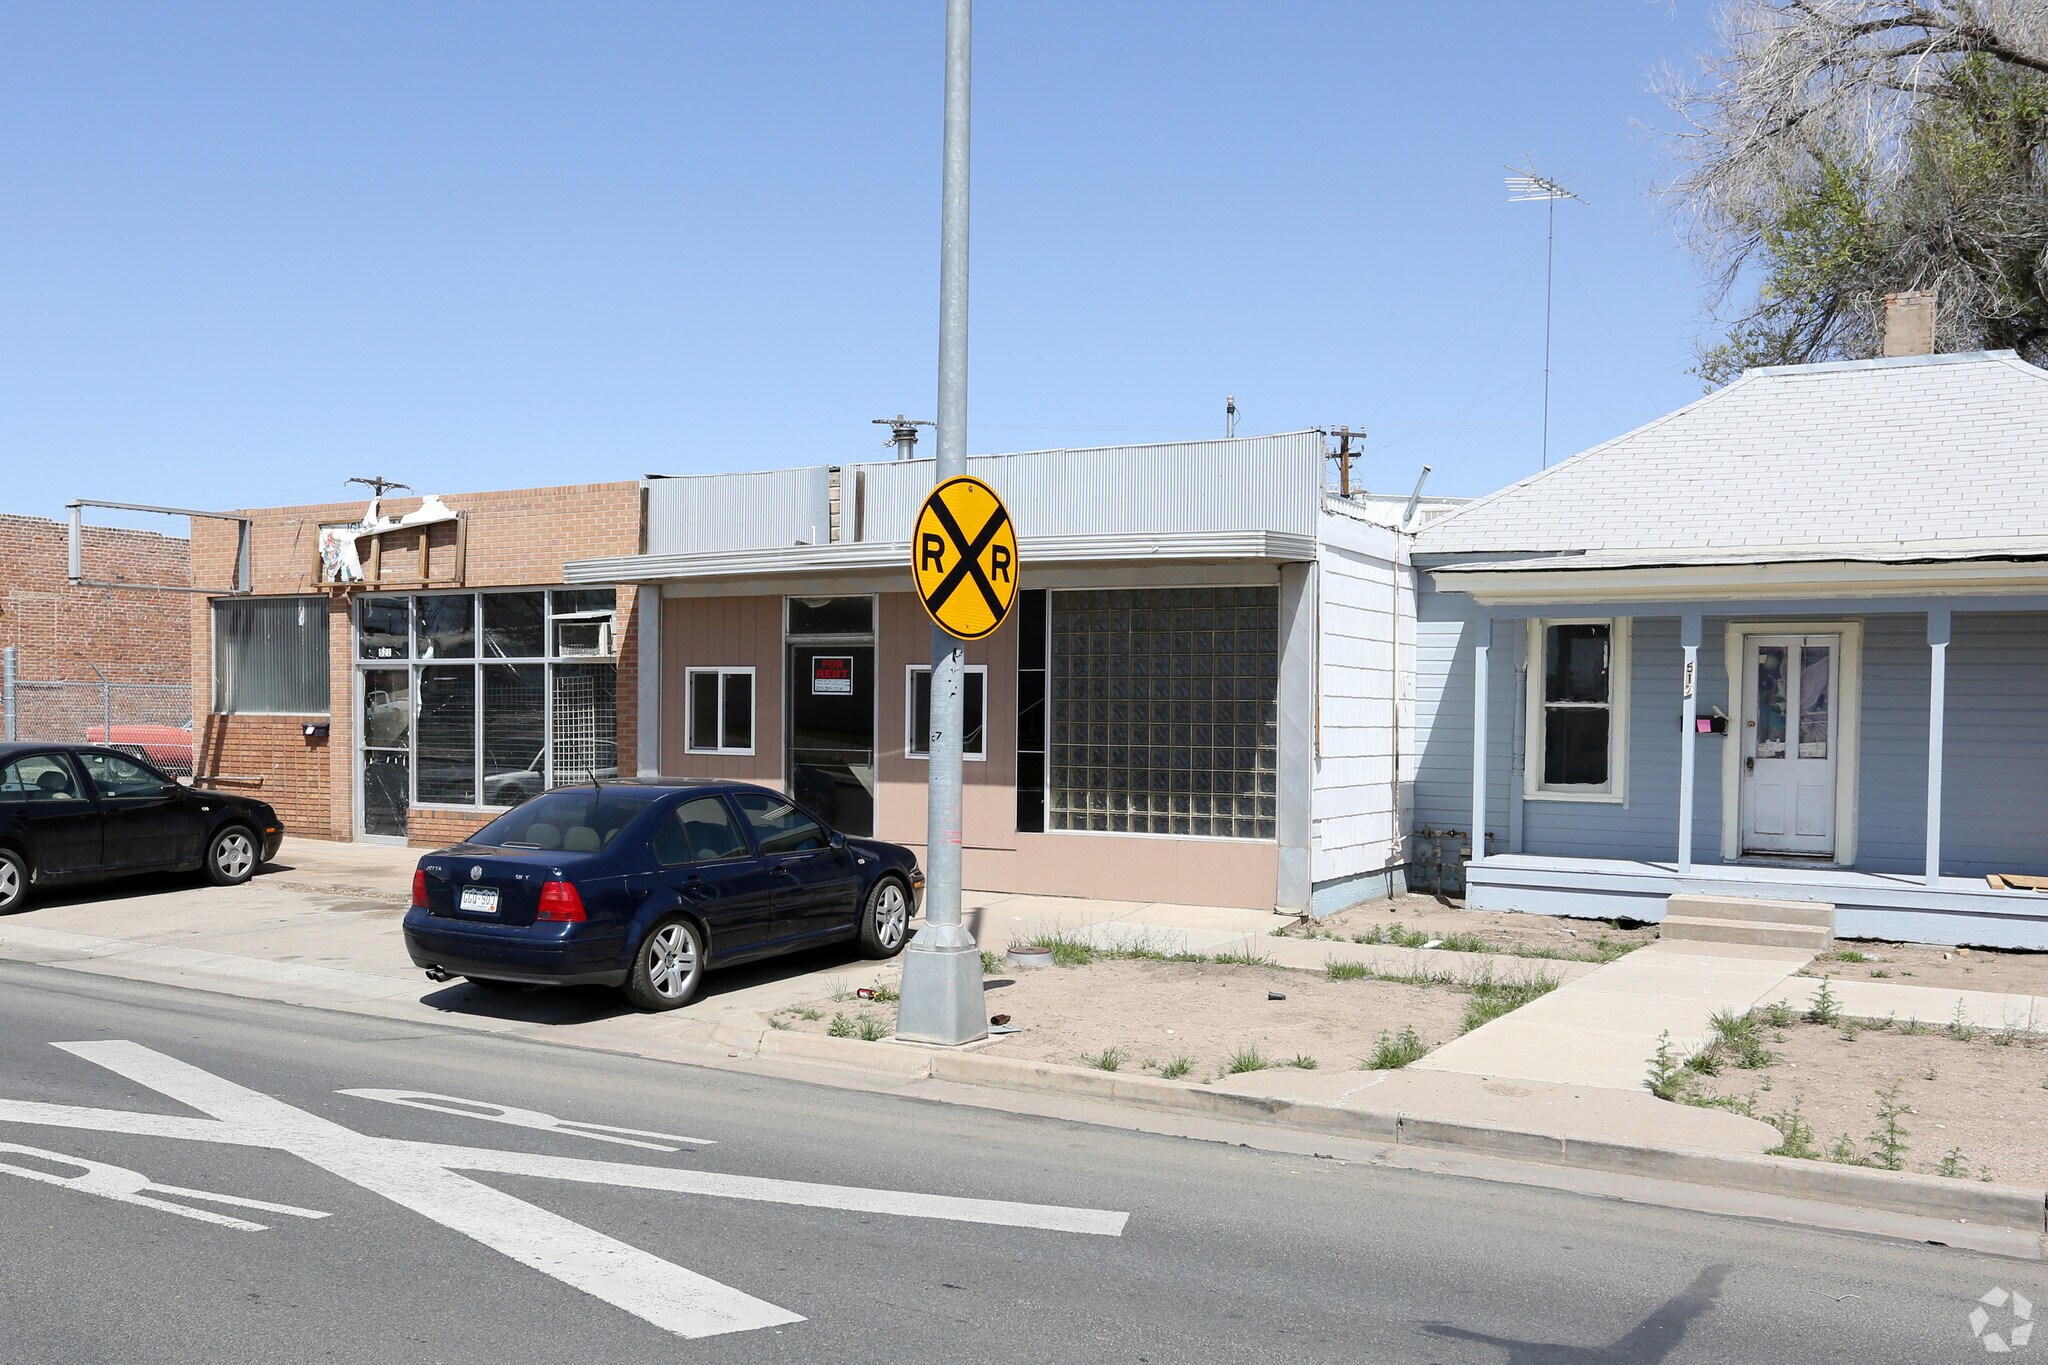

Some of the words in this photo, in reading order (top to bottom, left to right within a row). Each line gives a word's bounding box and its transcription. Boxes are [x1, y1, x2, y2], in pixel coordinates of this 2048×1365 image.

[922, 532, 945, 573] R
[991, 544, 1011, 583] R
[821, 659, 843, 668] FOR
[815, 669, 848, 678] RENT
